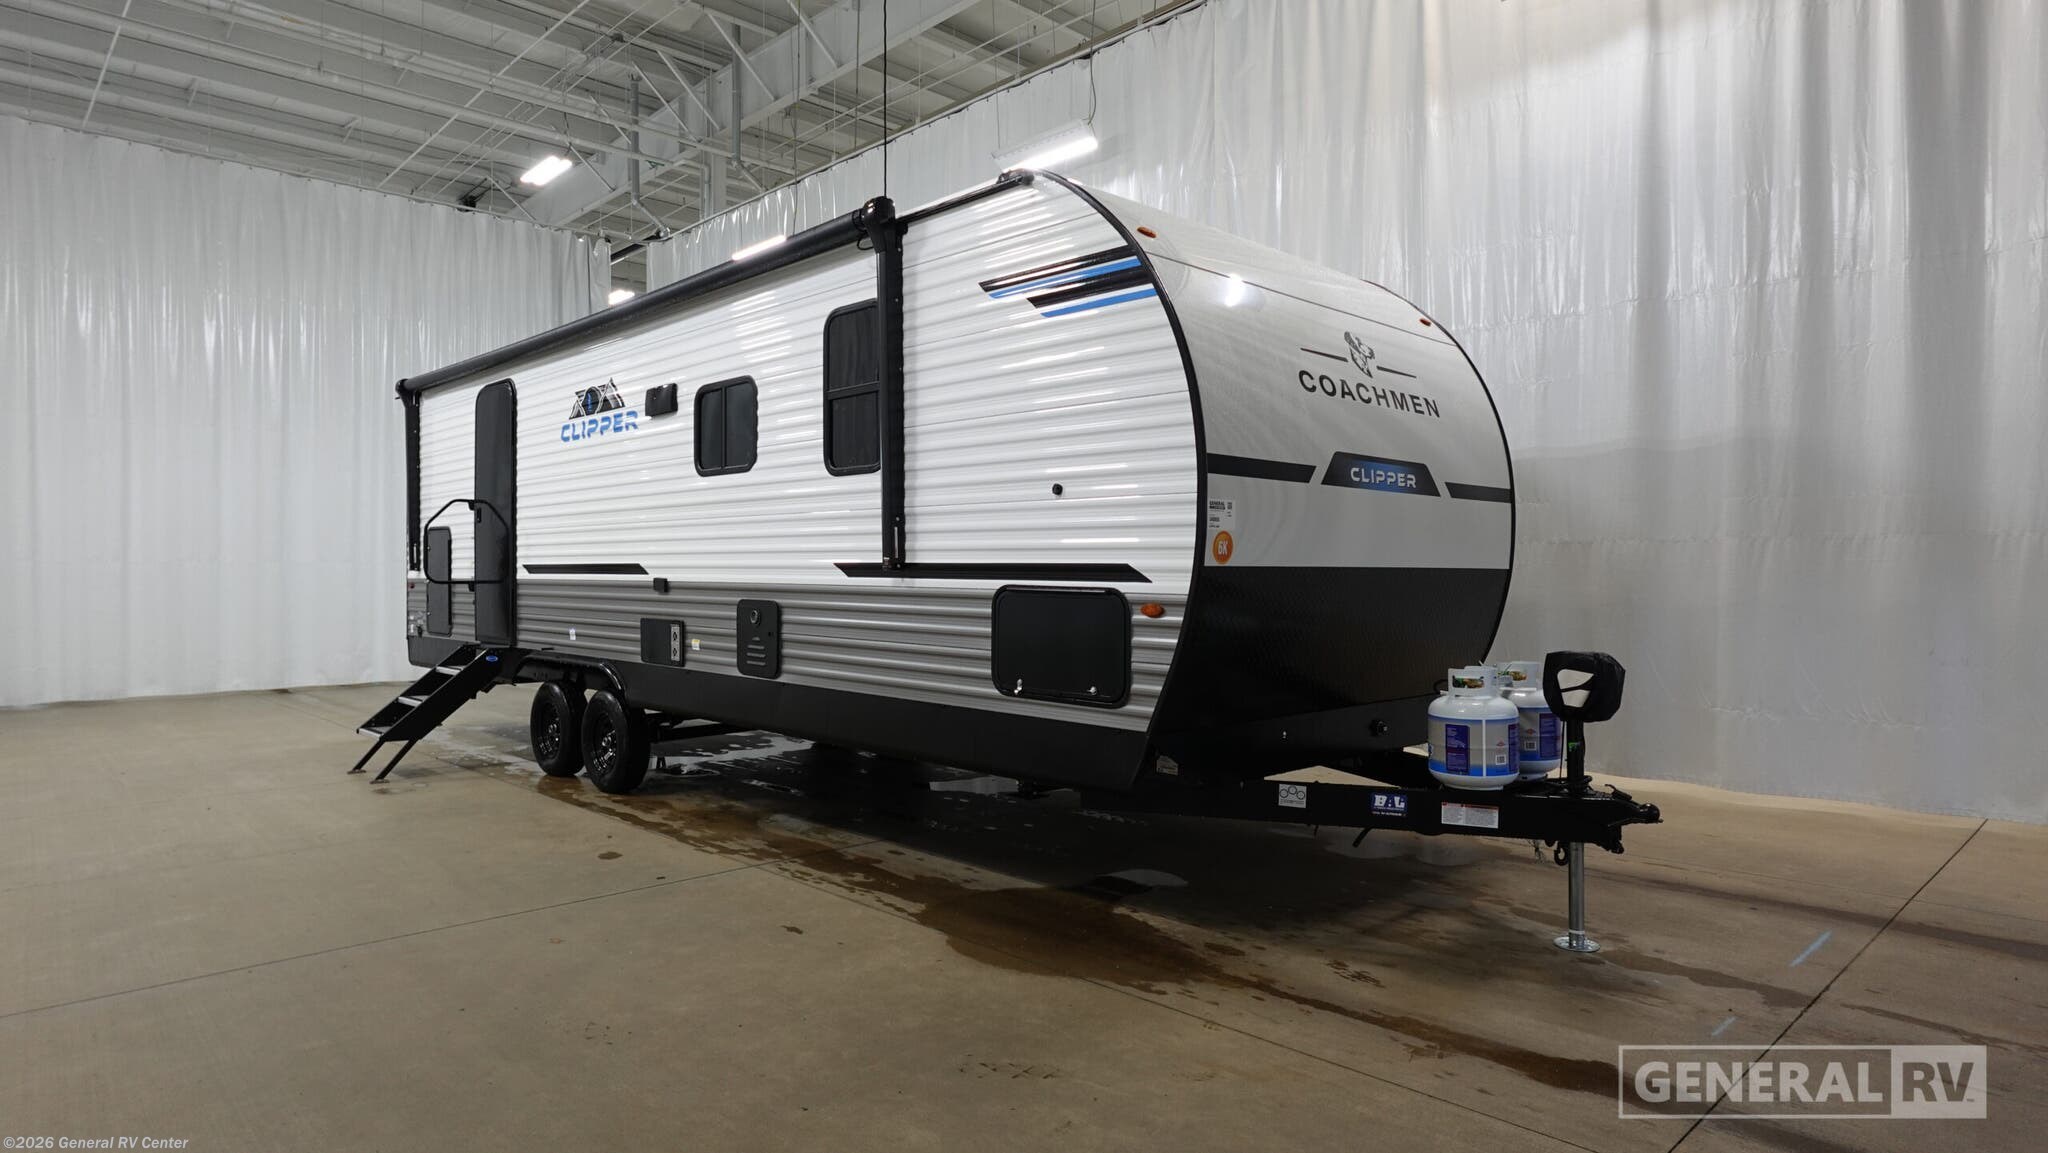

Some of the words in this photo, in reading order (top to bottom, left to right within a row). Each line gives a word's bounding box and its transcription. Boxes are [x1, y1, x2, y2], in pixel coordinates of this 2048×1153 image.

[1298, 369, 1441, 418] COACHMEN
[560, 410, 639, 443] CLIPPER
[1350, 466, 1417, 489] CLIPPER
